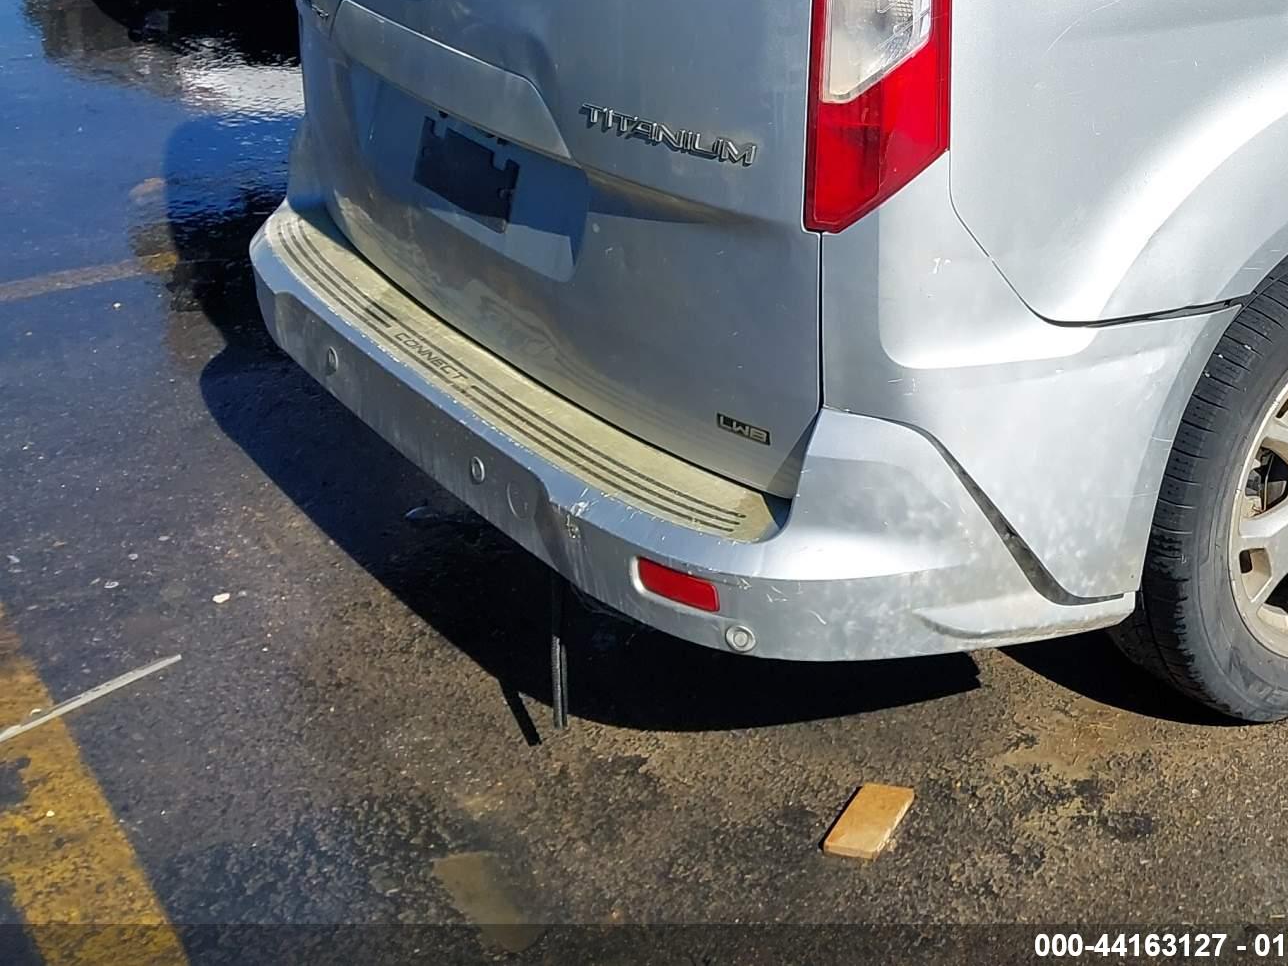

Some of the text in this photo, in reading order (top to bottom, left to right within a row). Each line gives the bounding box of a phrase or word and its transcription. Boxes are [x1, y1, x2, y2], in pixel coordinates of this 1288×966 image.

[581, 103, 758, 166] TITANIUM
[394, 332, 468, 379] CONNECT
[719, 415, 767, 442] LWB
